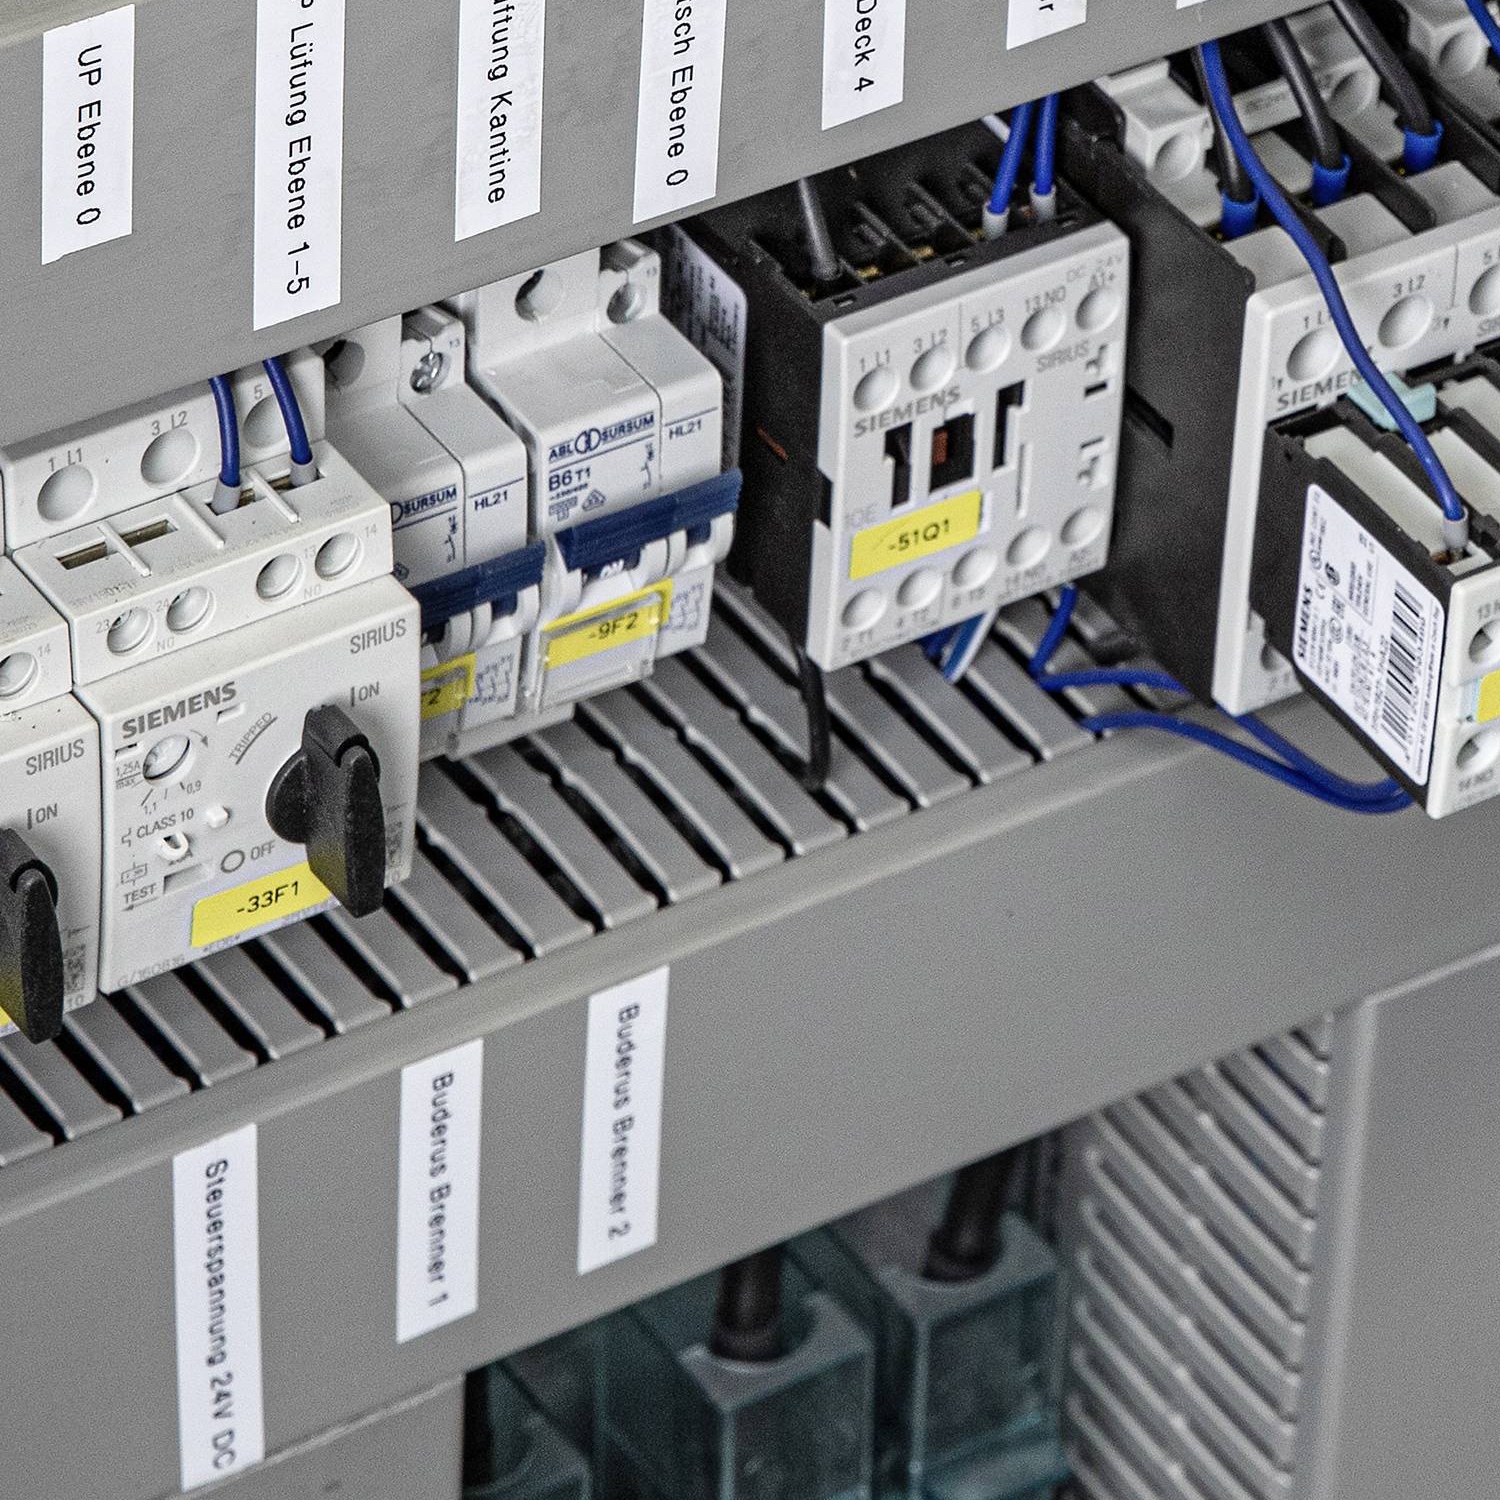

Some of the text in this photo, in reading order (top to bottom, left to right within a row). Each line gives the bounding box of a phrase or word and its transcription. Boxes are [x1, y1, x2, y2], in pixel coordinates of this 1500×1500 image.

[283, 24, 315, 126] Lüfung
[854, 75, 876, 94] 4
[666, 64, 694, 160] Ebene
[76, 45, 103, 227] UP Ebene 0
[486, 89, 514, 205] Kantine
[287, 137, 312, 231] Ebene
[665, 167, 689, 188] 0
[285, 241, 311, 297] 1-5
[669, 420, 702, 439] HL21
[853, 386, 961, 438] SIEMENS
[548, 414, 655, 460] ABL SURSUM
[548, 471, 571, 491] B6
[404, 486, 457, 515] SURSUM
[888, 520, 950, 553] -51Q1
[350, 619, 407, 654] SIRIUS
[588, 613, 638, 640] -9F2
[358, 681, 380, 701] ON
[121, 681, 238, 740] SIEMENS
[228, 712, 273, 760] TRIPPED
[26, 740, 84, 775] SIRIUS
[36, 804, 58, 823] ON
[137, 808, 195, 839] CLASS 10
[251, 840, 276, 860] OFF
[123, 883, 157, 904] TEST
[237, 882, 300, 914] -33F1
[608, 1003, 641, 1240] Buderus Brenner 2
[427, 1071, 454, 1307] Buderus Brenner 1
[204, 1158, 237, 1469] Steuerspannung 24V DC
